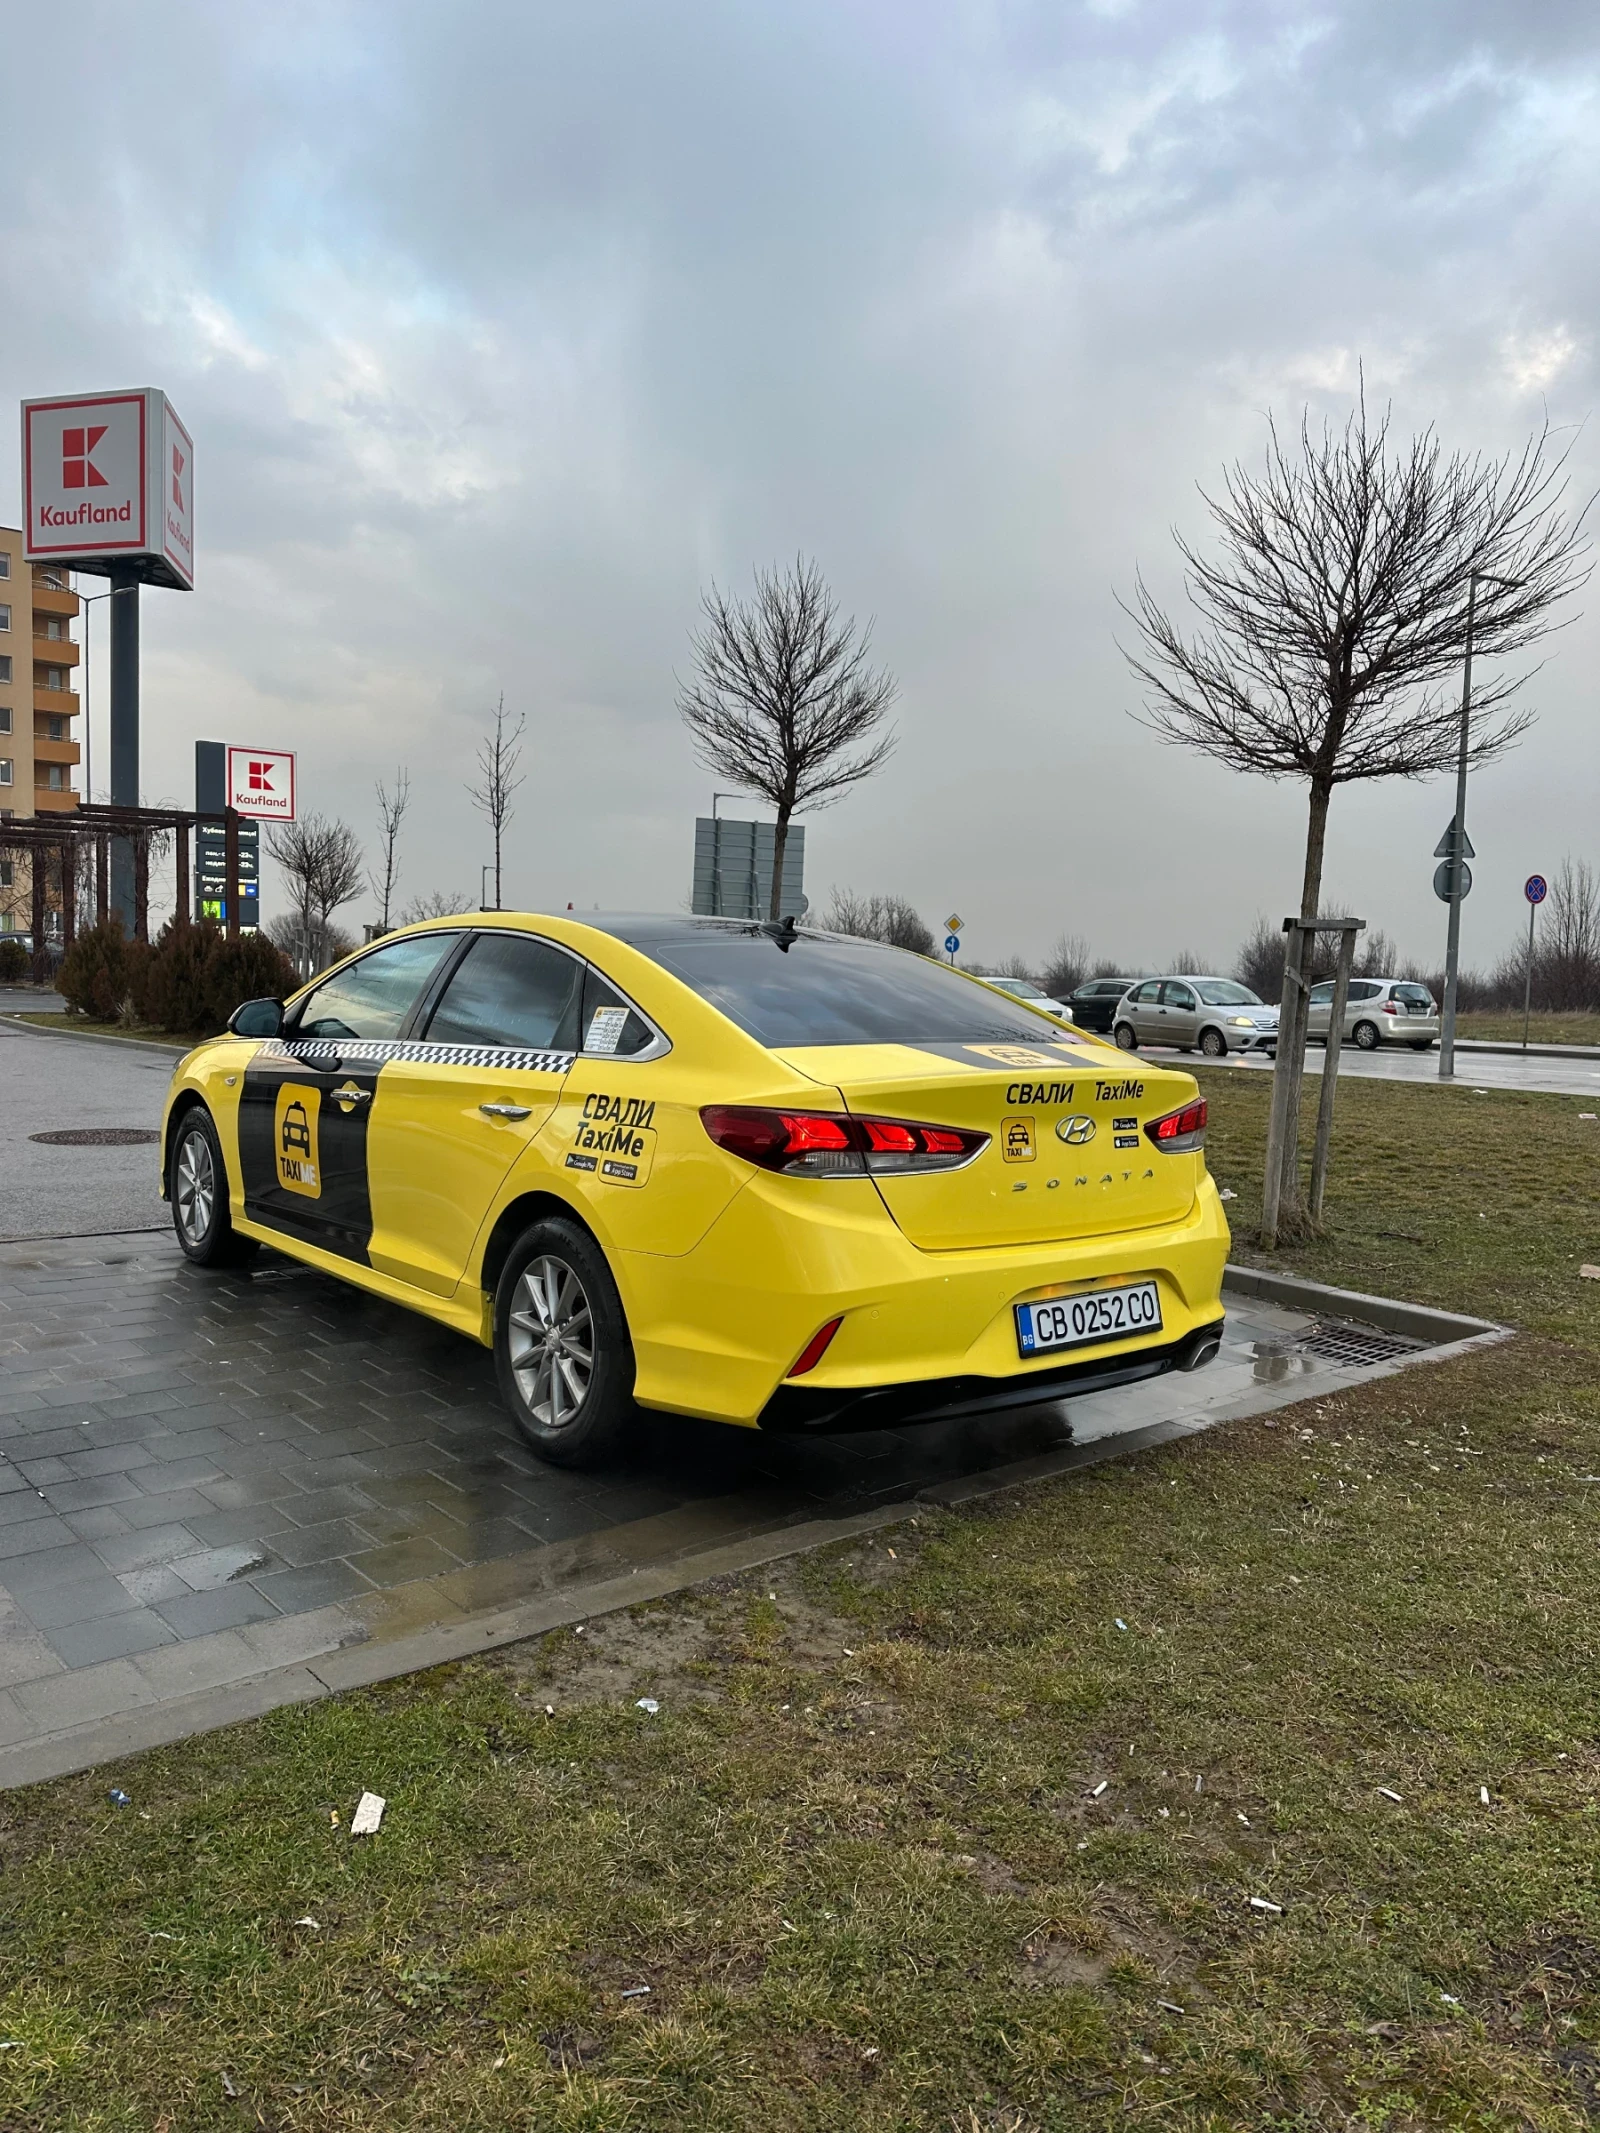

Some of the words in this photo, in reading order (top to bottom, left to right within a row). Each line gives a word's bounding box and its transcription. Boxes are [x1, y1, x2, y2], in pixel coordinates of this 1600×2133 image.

[40, 500, 131, 527] Kaufland
[167, 508, 190, 554] Kaufland
[236, 793, 287, 808] Kaufland
[1006, 1083, 1075, 1105] СВАЛИ
[1095, 1079, 1144, 1101] TaxiMe
[583, 1093, 656, 1128] СВАЛИ
[574, 1121, 645, 1158] TaxiMe
[1006, 1146, 1033, 1158] TAXIME
[280, 1156, 317, 1187] TAXIME
[573, 1159, 587, 1169] Google
[611, 1167, 621, 1176] App
[621, 1168, 634, 1178] Store
[1012, 1169, 1154, 1192] SONATA
[1036, 1306, 1068, 1343] CB
[1072, 1296, 1126, 1336] 0252
[1128, 1290, 1155, 1325] CO
[1022, 1334, 1034, 1347] BG
